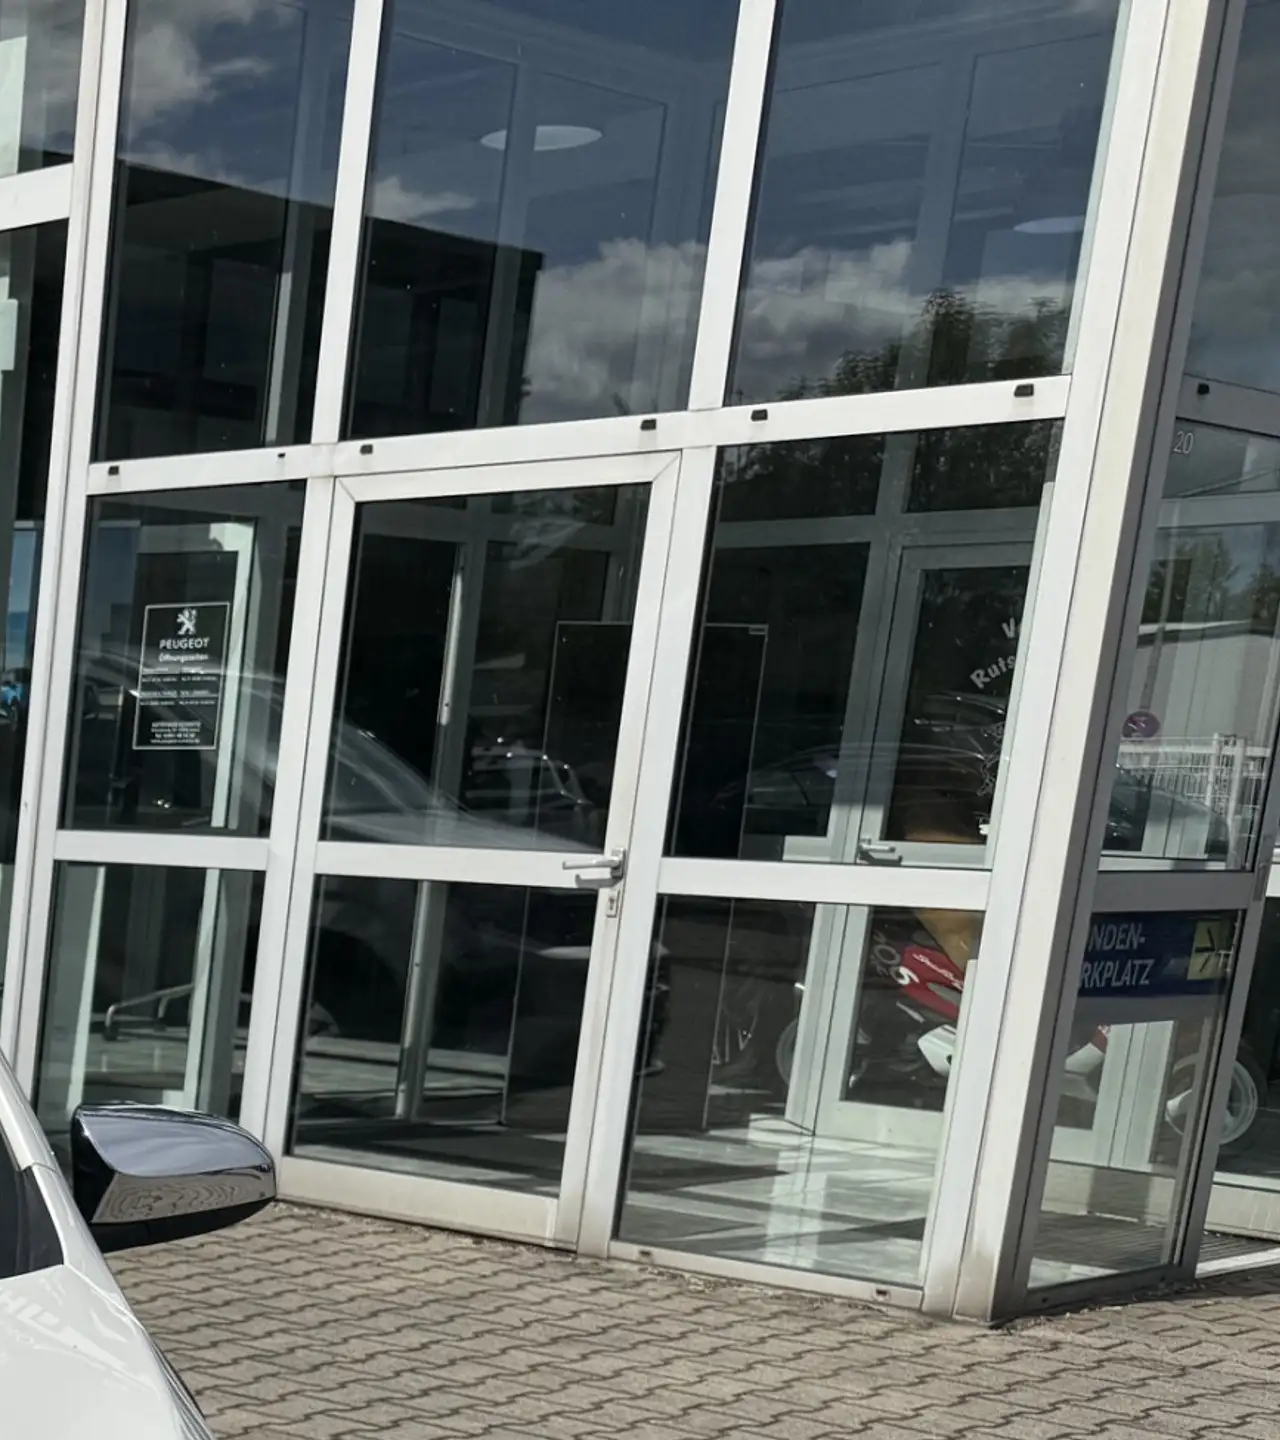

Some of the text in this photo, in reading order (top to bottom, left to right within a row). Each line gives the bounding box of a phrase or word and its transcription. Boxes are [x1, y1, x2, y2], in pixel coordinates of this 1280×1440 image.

[1172, 430, 1194, 455] 20
[159, 637, 210, 650] PEUGEOT
[969, 655, 1017, 689] Ruts
